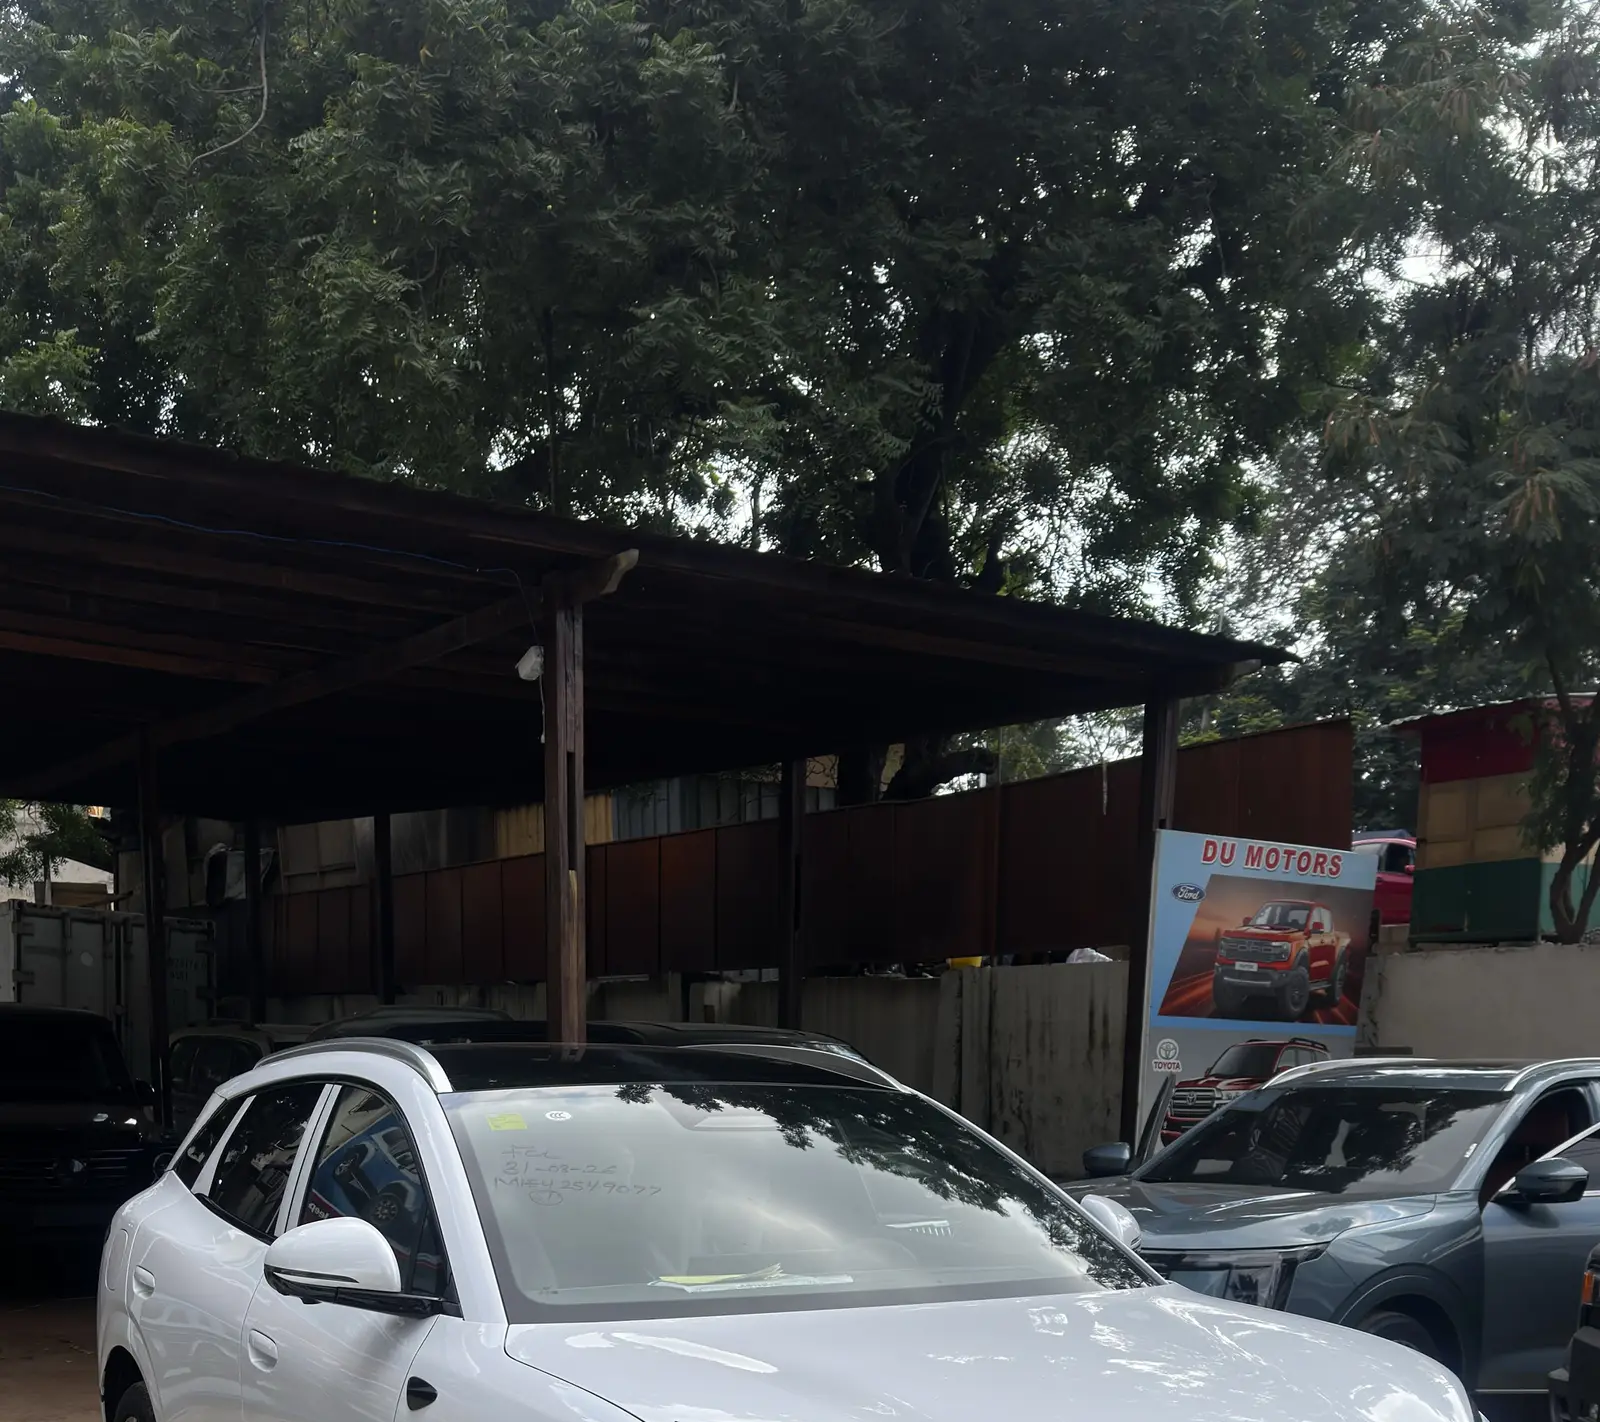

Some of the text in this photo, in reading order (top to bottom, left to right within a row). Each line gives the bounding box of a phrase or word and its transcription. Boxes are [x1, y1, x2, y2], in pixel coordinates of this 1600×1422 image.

[1201, 839, 1343, 878] DU MOTORS
[1177, 885, 1200, 900] Ford
[1153, 1060, 1181, 1072] TOYOTA
